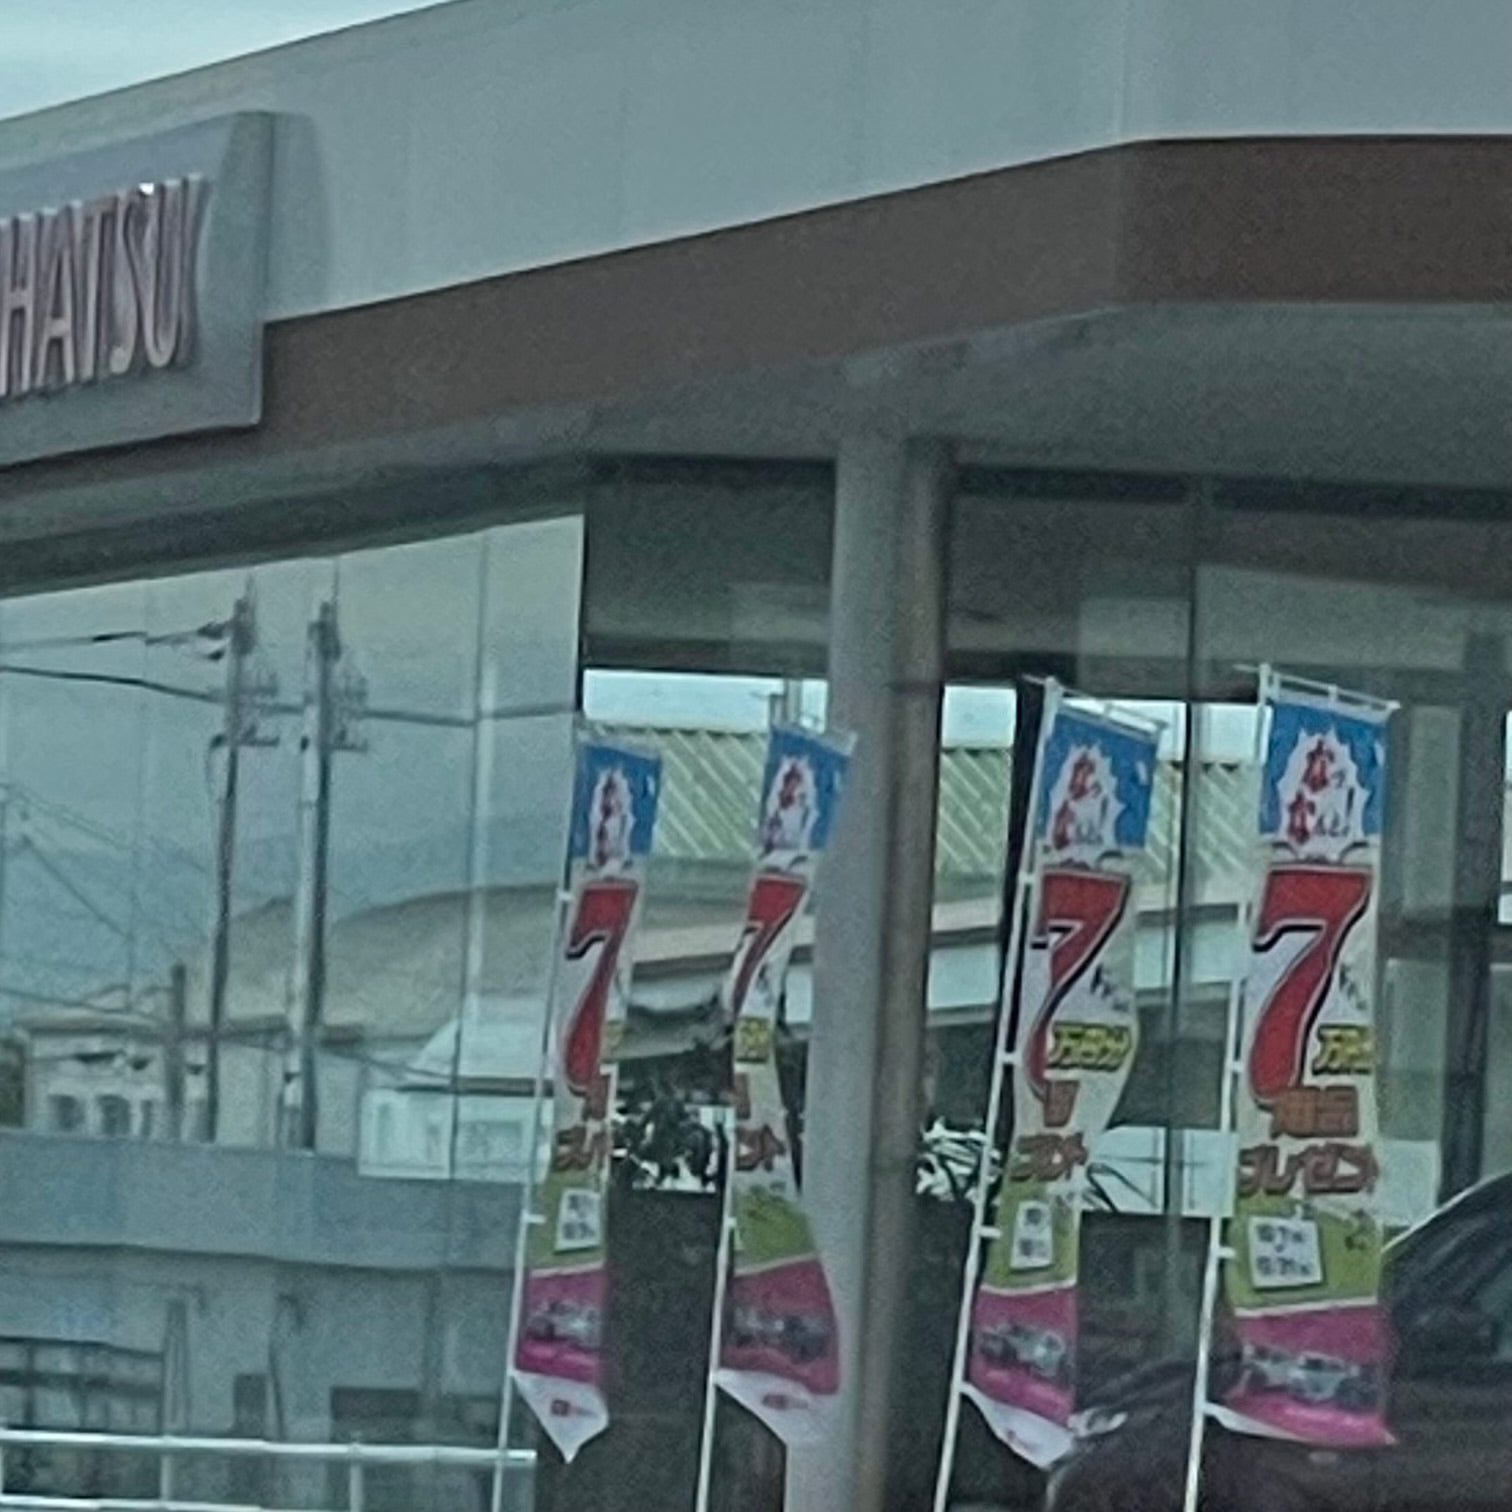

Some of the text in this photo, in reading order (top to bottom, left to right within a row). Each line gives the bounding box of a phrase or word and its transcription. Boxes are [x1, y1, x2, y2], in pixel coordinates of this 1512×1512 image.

[564, 878, 640, 1095] 7
[1024, 864, 1131, 1104] 7
[1248, 862, 1375, 1110] 7
